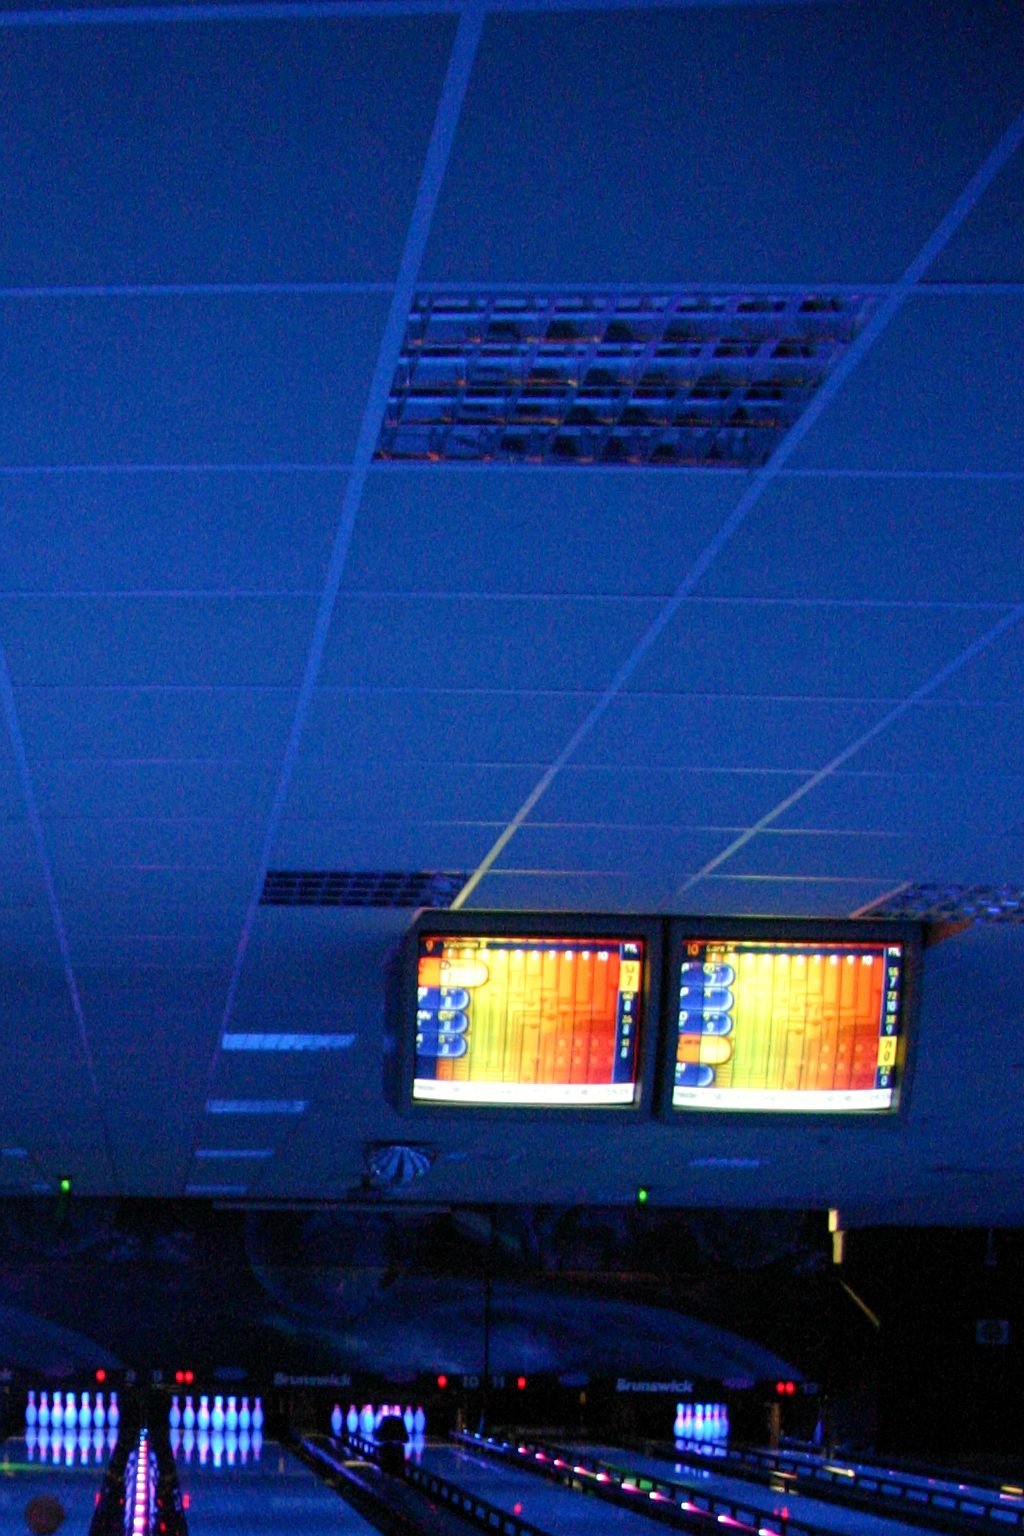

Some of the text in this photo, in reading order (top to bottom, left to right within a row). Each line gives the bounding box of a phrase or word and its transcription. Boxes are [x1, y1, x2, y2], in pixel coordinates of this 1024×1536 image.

[274, 1372, 351, 1386] Brunswick
[462, 1375, 479, 1389] 10
[615, 1378, 694, 1393] Brunswick
